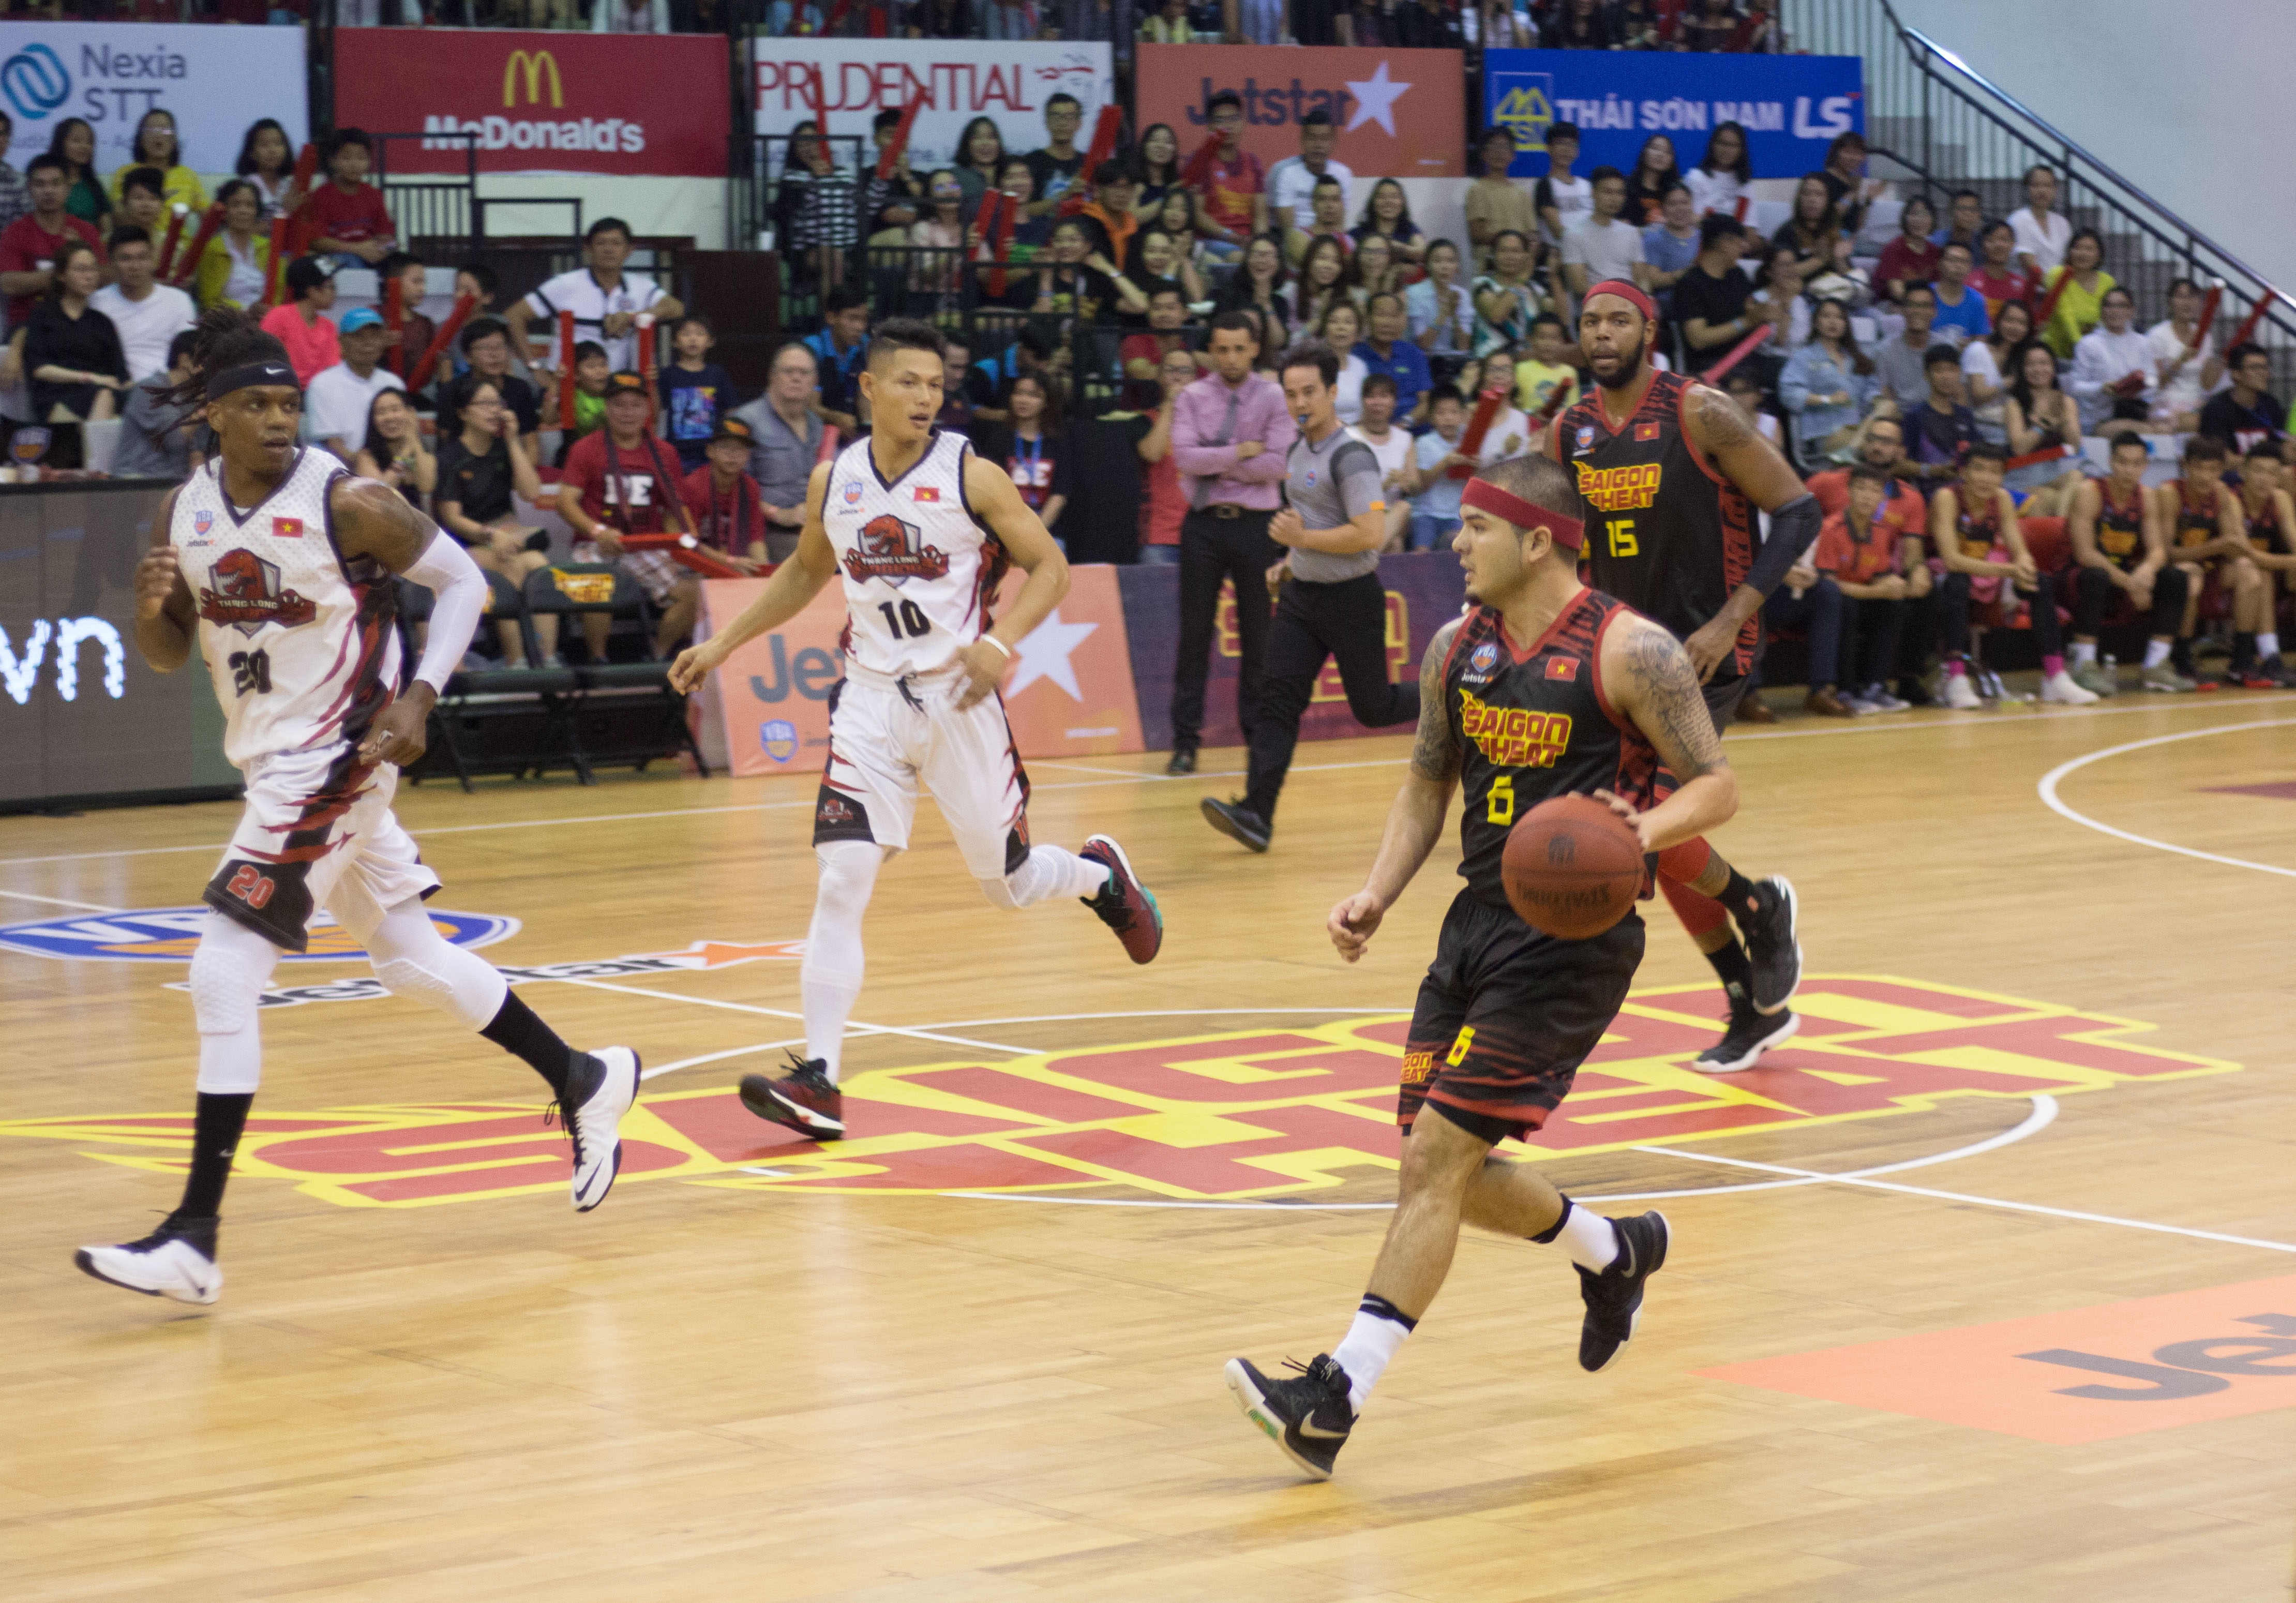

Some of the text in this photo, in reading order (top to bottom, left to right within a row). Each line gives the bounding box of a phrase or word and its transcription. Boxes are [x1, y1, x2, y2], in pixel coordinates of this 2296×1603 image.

[81, 43, 187, 79] Nexia
[84, 86, 162, 122] STT
[1714, 101, 1783, 131] NAM
[1793, 96, 1856, 139] LS
[422, 115, 645, 152] McDonald's
[1579, 463, 1661, 495] SAIGON
[1596, 485, 1658, 512] HEAT
[1605, 519, 1639, 557] 15
[878, 599, 931, 639] 10
[1463, 706, 1572, 745] SAIGON
[1488, 736, 1565, 768] HEAT
[1487, 776, 1514, 825] 6
[226, 864, 275, 909] 20
[1446, 1025, 1476, 1067] 6
